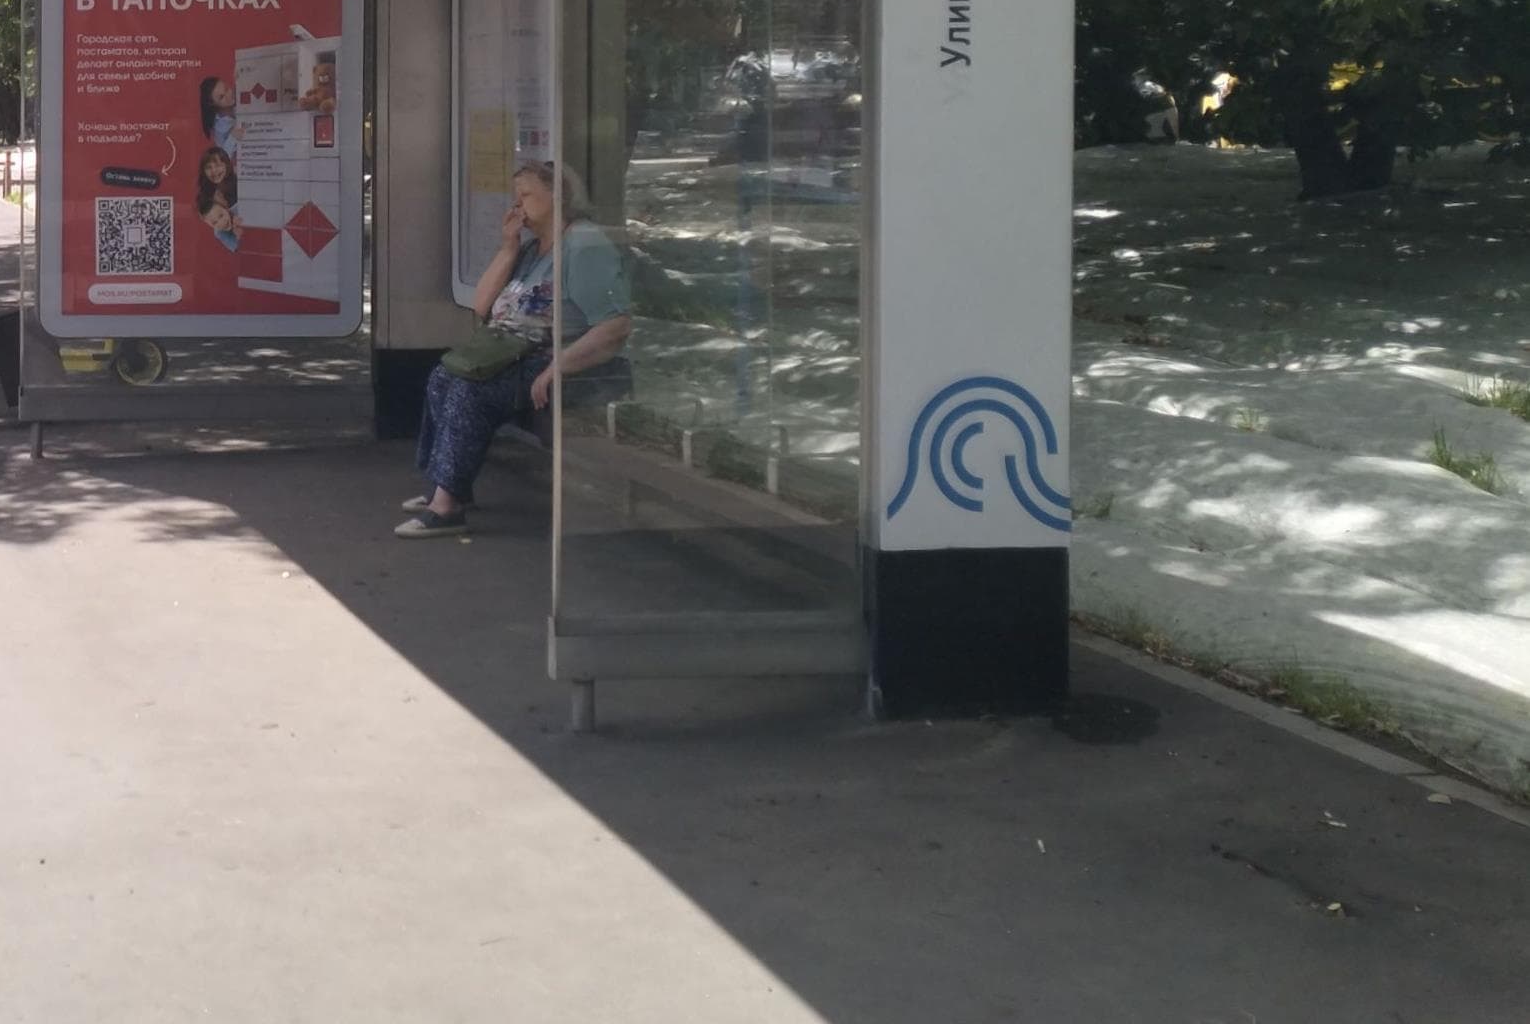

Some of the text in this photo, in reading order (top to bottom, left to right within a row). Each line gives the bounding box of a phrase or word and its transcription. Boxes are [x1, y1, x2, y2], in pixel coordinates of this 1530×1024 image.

[76, 34, 132, 45] Городская
[144, 47, 187, 57] которая
[77, 60, 113, 69] делает
[77, 72, 95, 81] для
[133, 71, 176, 82] удобнее
[87, 84, 120, 93] ближе
[77, 122, 170, 131] Хочешь постамат
[87, 133, 142, 143] подъезде?
